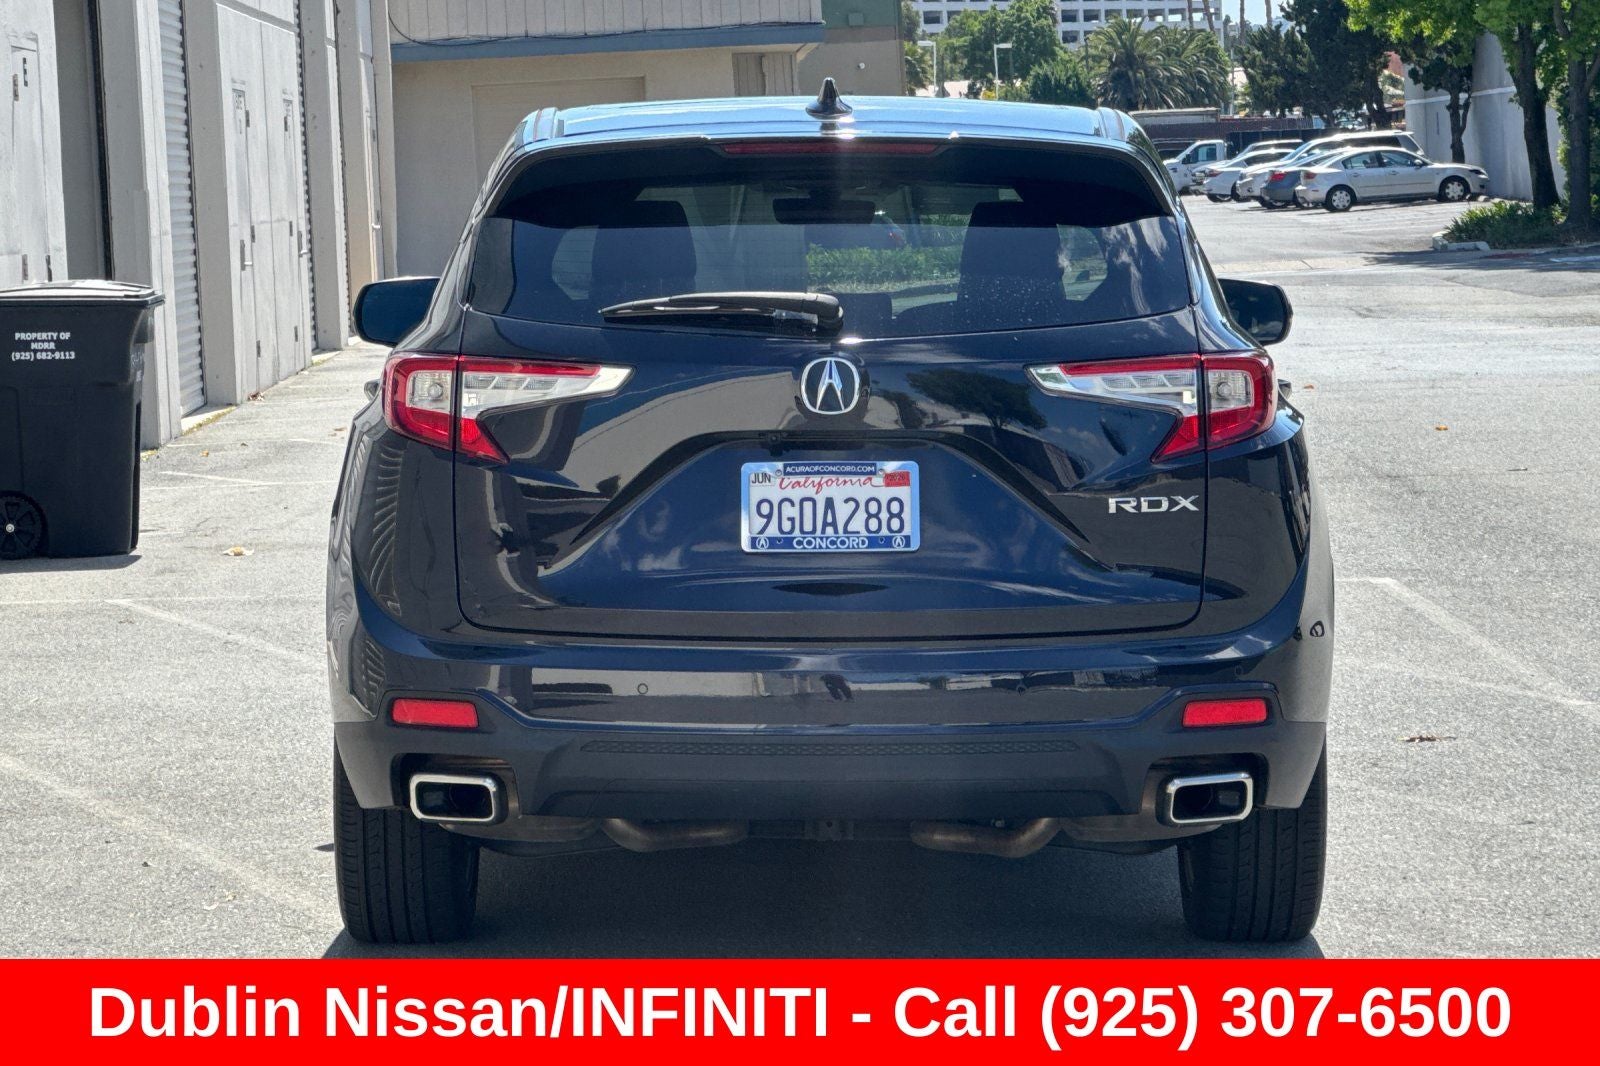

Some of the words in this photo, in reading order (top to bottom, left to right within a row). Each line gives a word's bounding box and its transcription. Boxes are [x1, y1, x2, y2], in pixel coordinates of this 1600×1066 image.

[15, 332, 58, 340] PROPERTY
[59, 332, 71, 340] OF
[30, 342, 56, 350] MDRR
[11, 351, 34, 361] (925)
[36, 351, 76, 360] 682-9113
[785, 466, 875, 474] ACURAOFCONCORD.COM
[751, 473, 772, 484] JUN
[779, 476, 880, 495] California
[1108, 495, 1200, 514] RDX
[793, 537, 869, 549] CONCORD
